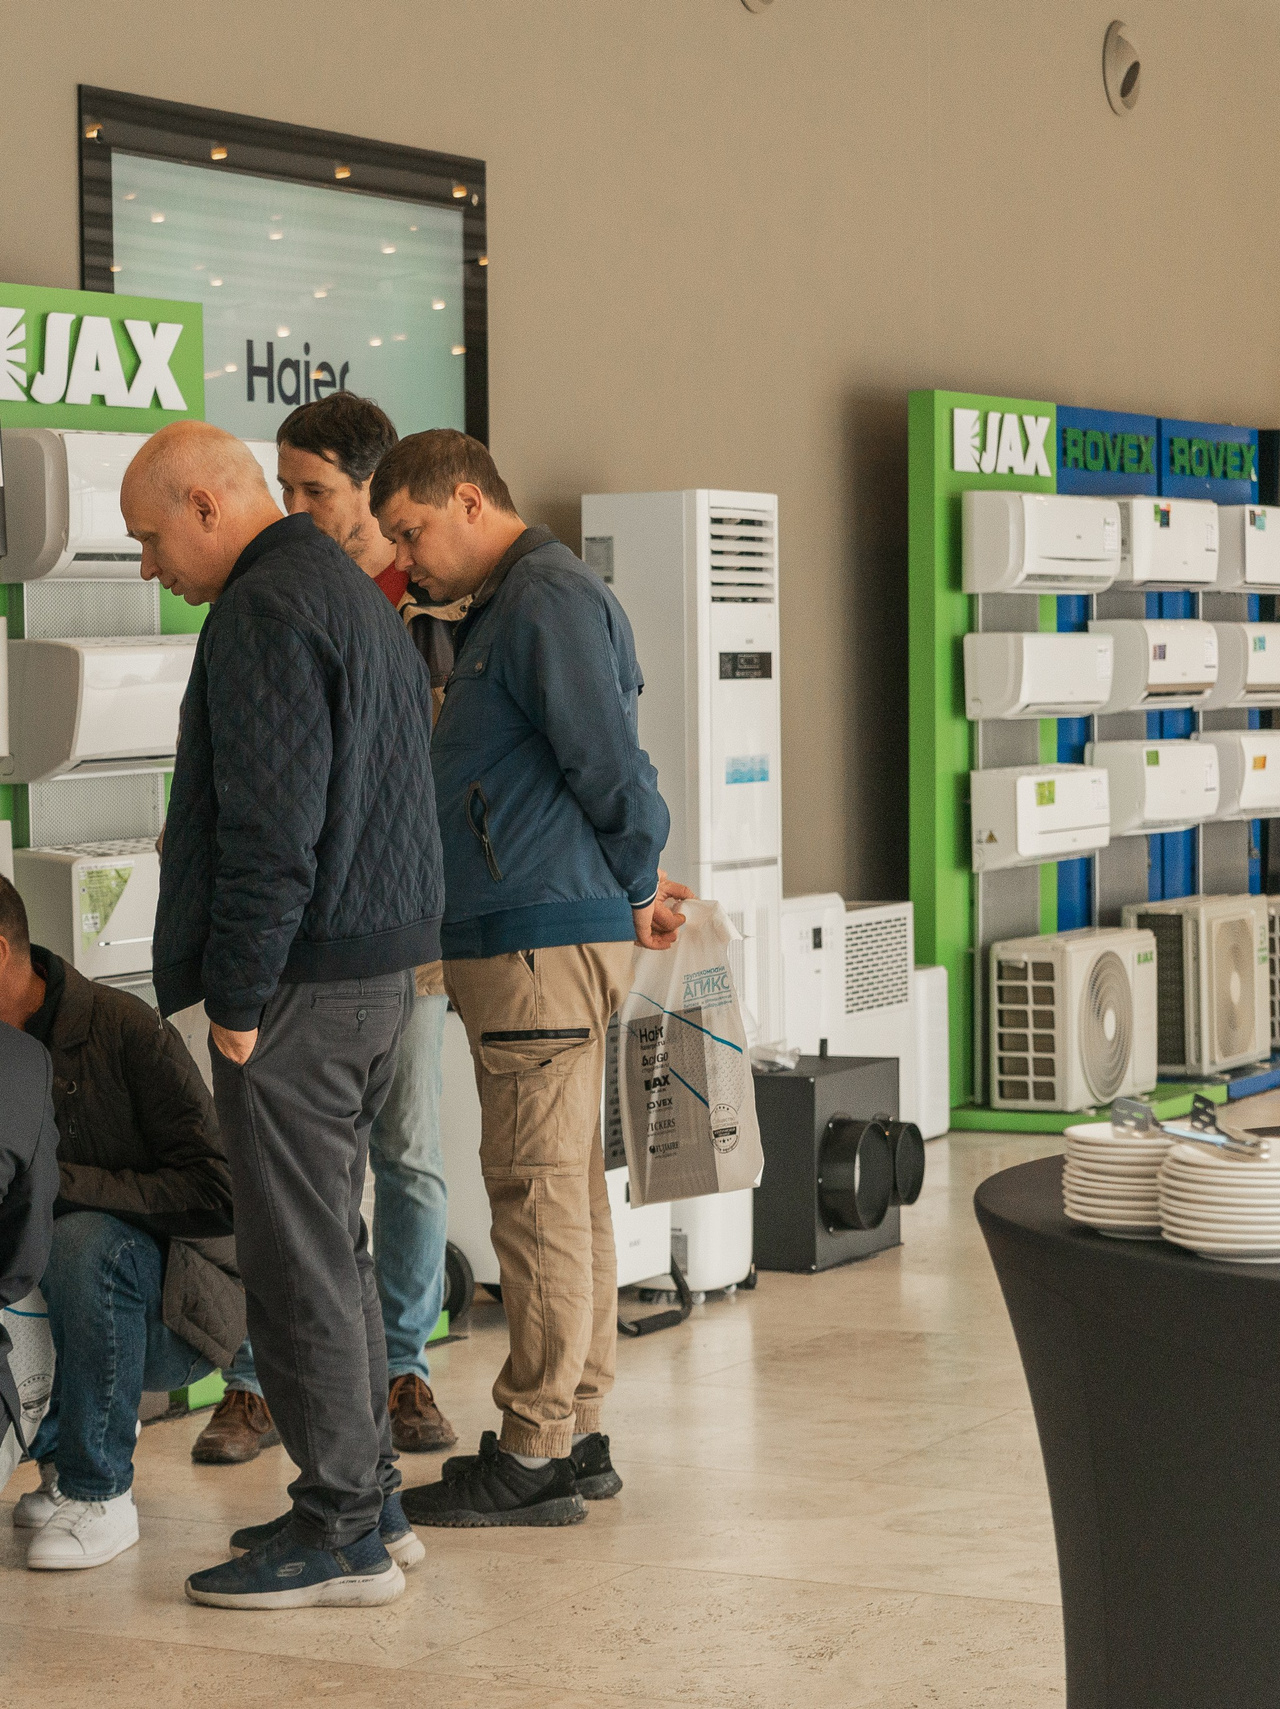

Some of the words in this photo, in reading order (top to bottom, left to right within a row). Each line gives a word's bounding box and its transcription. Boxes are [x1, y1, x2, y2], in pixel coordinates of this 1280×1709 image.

[246, 339, 349, 405] Haier
[1063, 427, 1155, 474] ROVEX
[1170, 437, 1256, 480] ROVEX
[683, 974, 730, 1000] АПИКС
